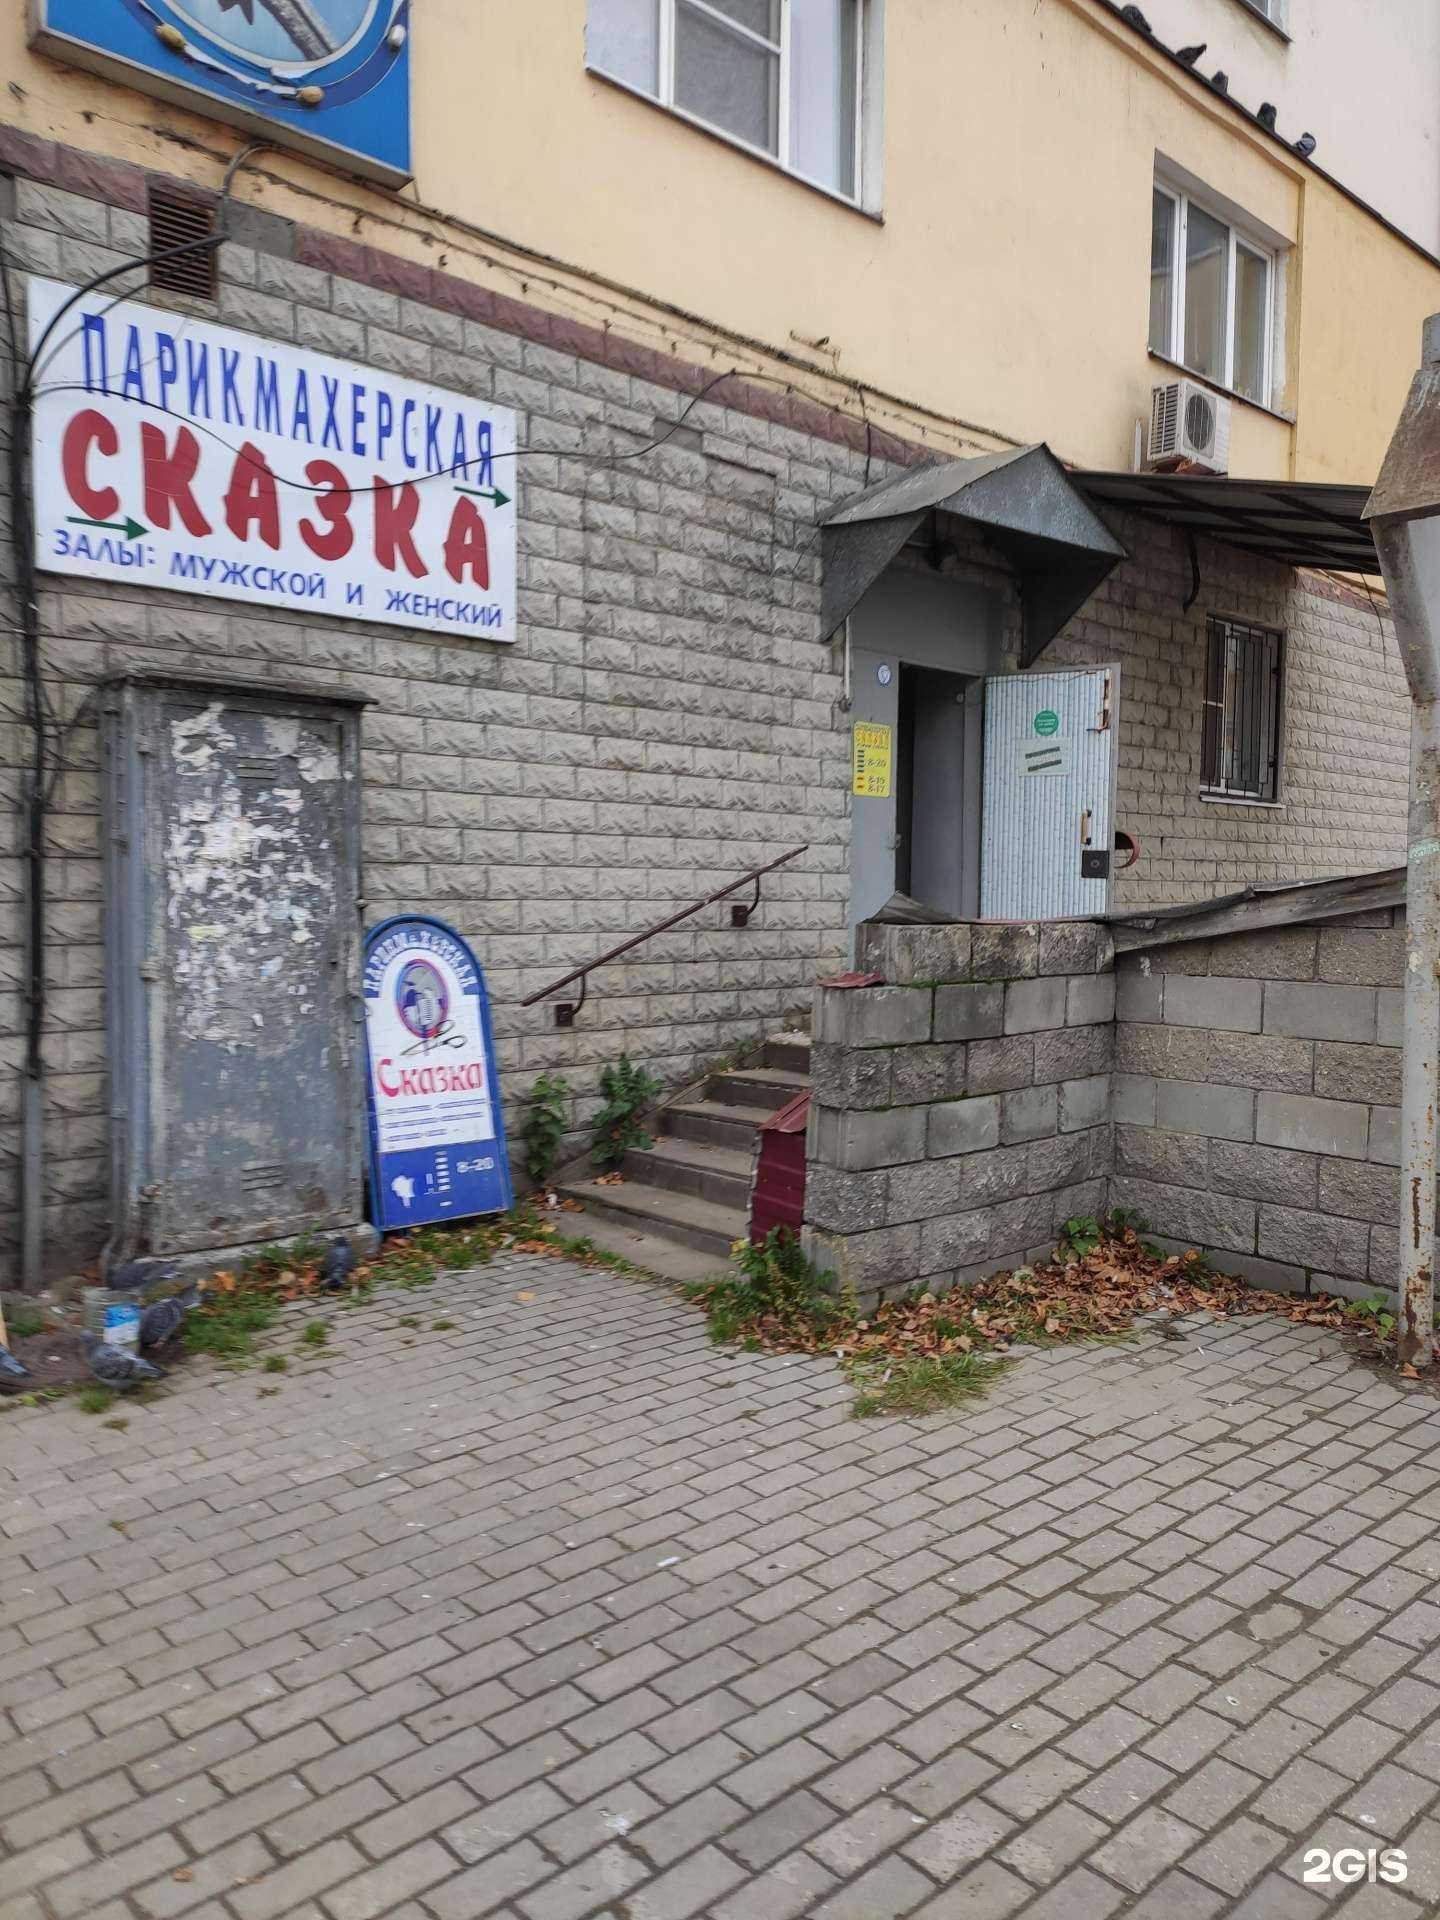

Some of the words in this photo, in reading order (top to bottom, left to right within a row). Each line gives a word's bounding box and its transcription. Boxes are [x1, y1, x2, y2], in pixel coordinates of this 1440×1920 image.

[82, 313, 494, 487] ПАРИКМАХЕРСКАЯ
[62, 408, 489, 591] СКАЗКА
[53, 529, 155, 567] ЗАЛЫ:
[169, 552, 326, 599] МУЖСКОЙ
[346, 583, 364, 605] И
[385, 588, 502, 627] ЖЕНСКИЙ
[377, 1059, 483, 1097] Сказка
